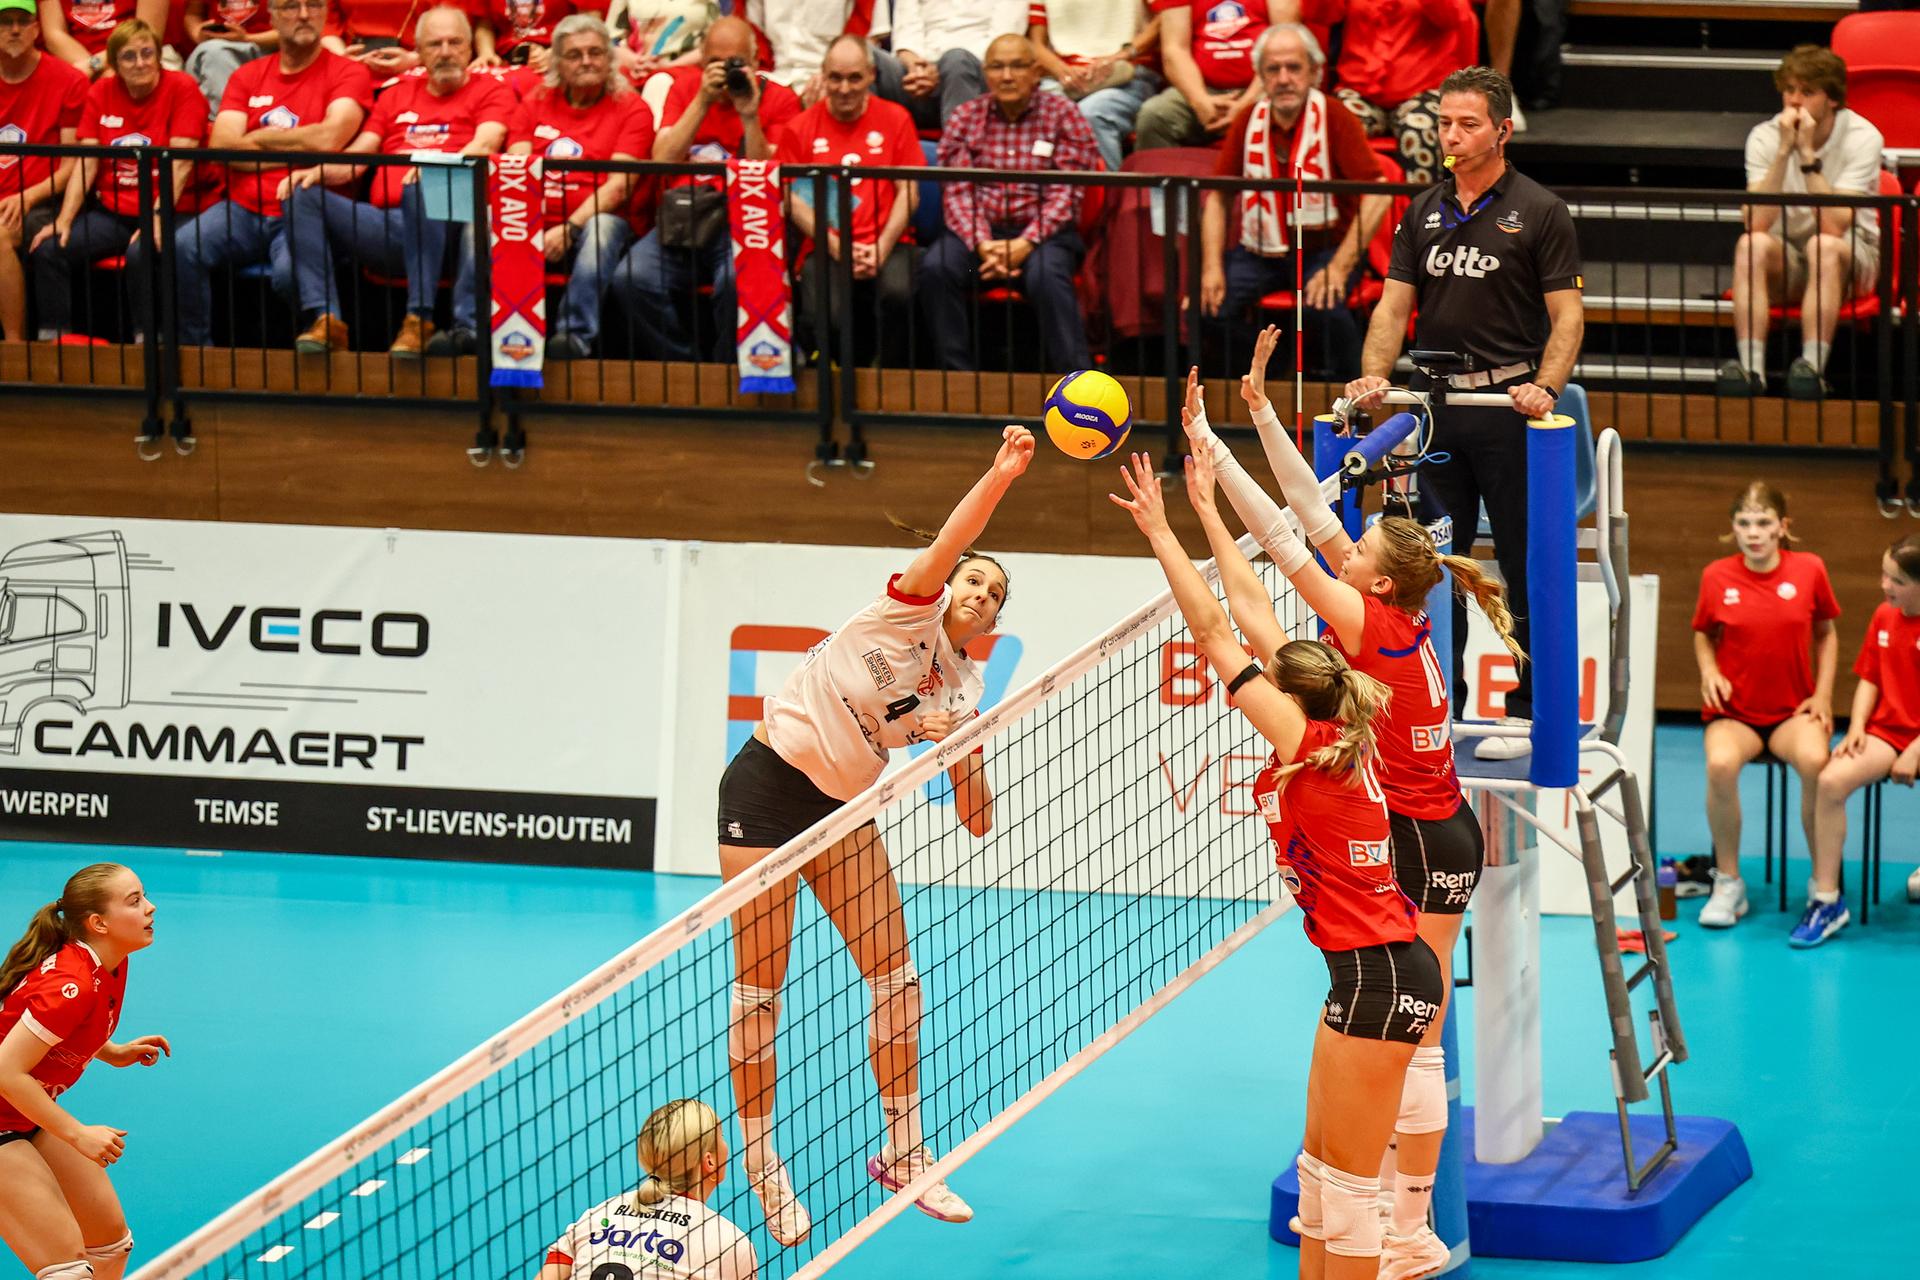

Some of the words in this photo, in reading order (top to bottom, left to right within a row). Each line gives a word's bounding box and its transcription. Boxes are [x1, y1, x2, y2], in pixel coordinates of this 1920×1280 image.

[500, 196, 529, 241] AVO
[741, 204, 769, 249] AVO
[157, 601, 429, 658] IVECO
[874, 652, 893, 681] REKKEN
[884, 694, 921, 723] 4
[34, 719, 425, 771] CAMMAERT
[0, 789, 109, 818] WERPEN
[194, 798, 279, 826] TEMSE
[366, 806, 632, 843] ST-LIEVENS-HOUTEM
